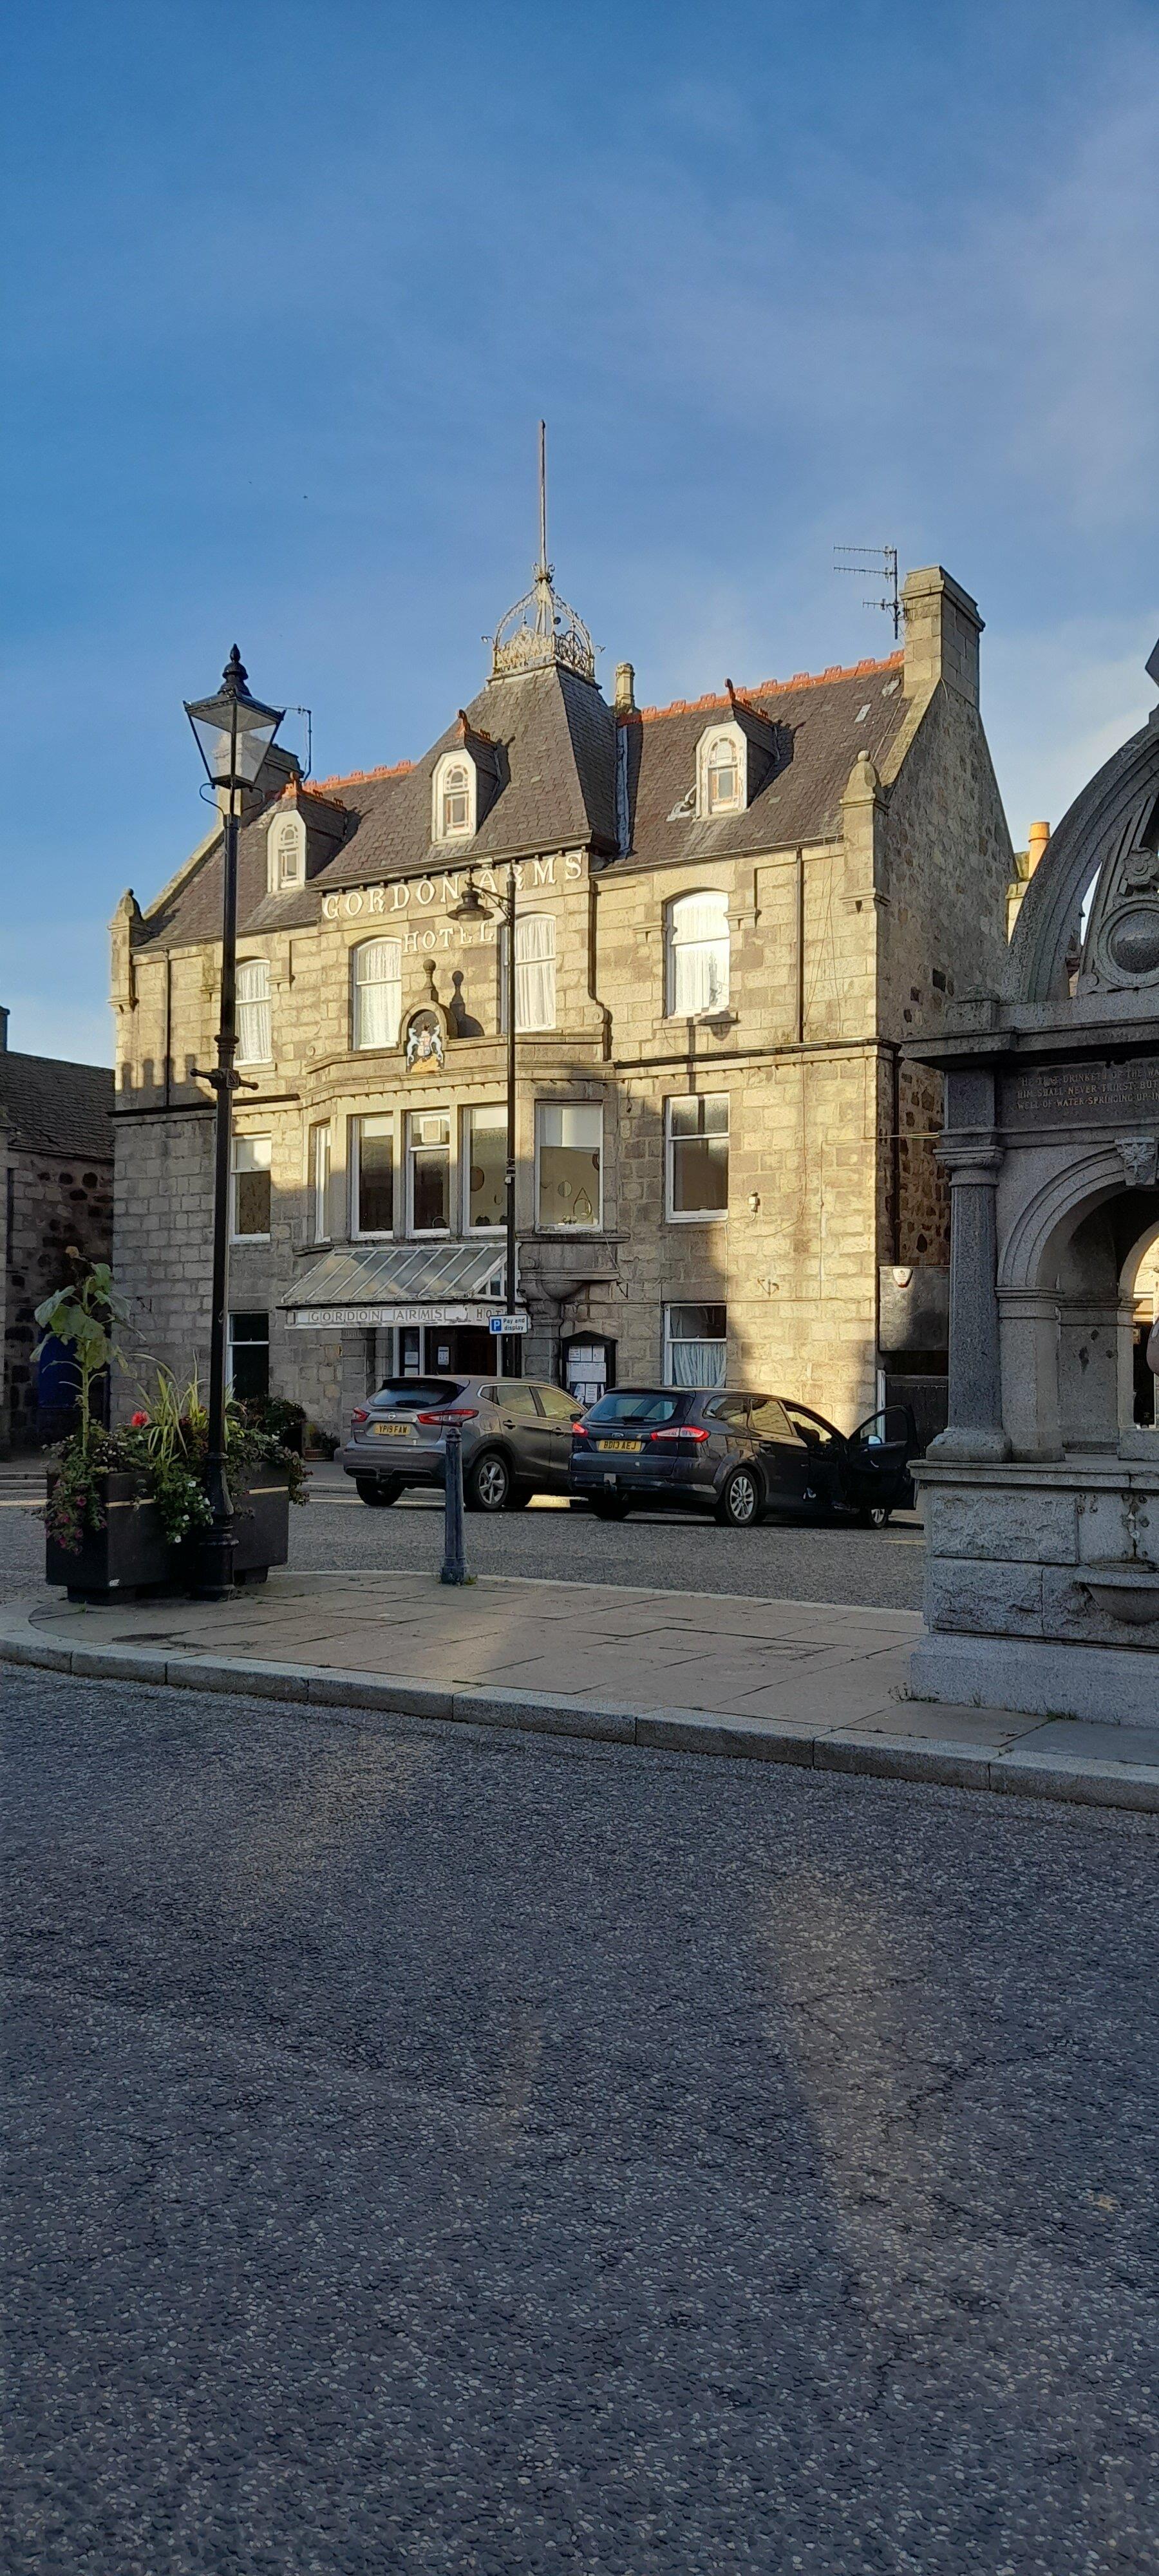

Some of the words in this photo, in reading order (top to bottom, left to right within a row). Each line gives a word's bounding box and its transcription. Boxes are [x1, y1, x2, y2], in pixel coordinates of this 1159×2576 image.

[323, 873, 460, 920] GORDON
[475, 853, 583, 893] ARMS
[402, 922, 494, 953] HOTEL
[1068, 1084, 1097, 1095] NEVER
[1140, 1080, 1158, 1089] BUT
[1055, 1097, 1084, 1107] WATER
[1087, 1093, 1134, 1105] SPRINGING
[311, 1309, 381, 1321] GORDON
[395, 1309, 443, 1321] ARMS
[493, 1320, 500, 1330] P
[621, 1441, 637, 1450] AEJ
